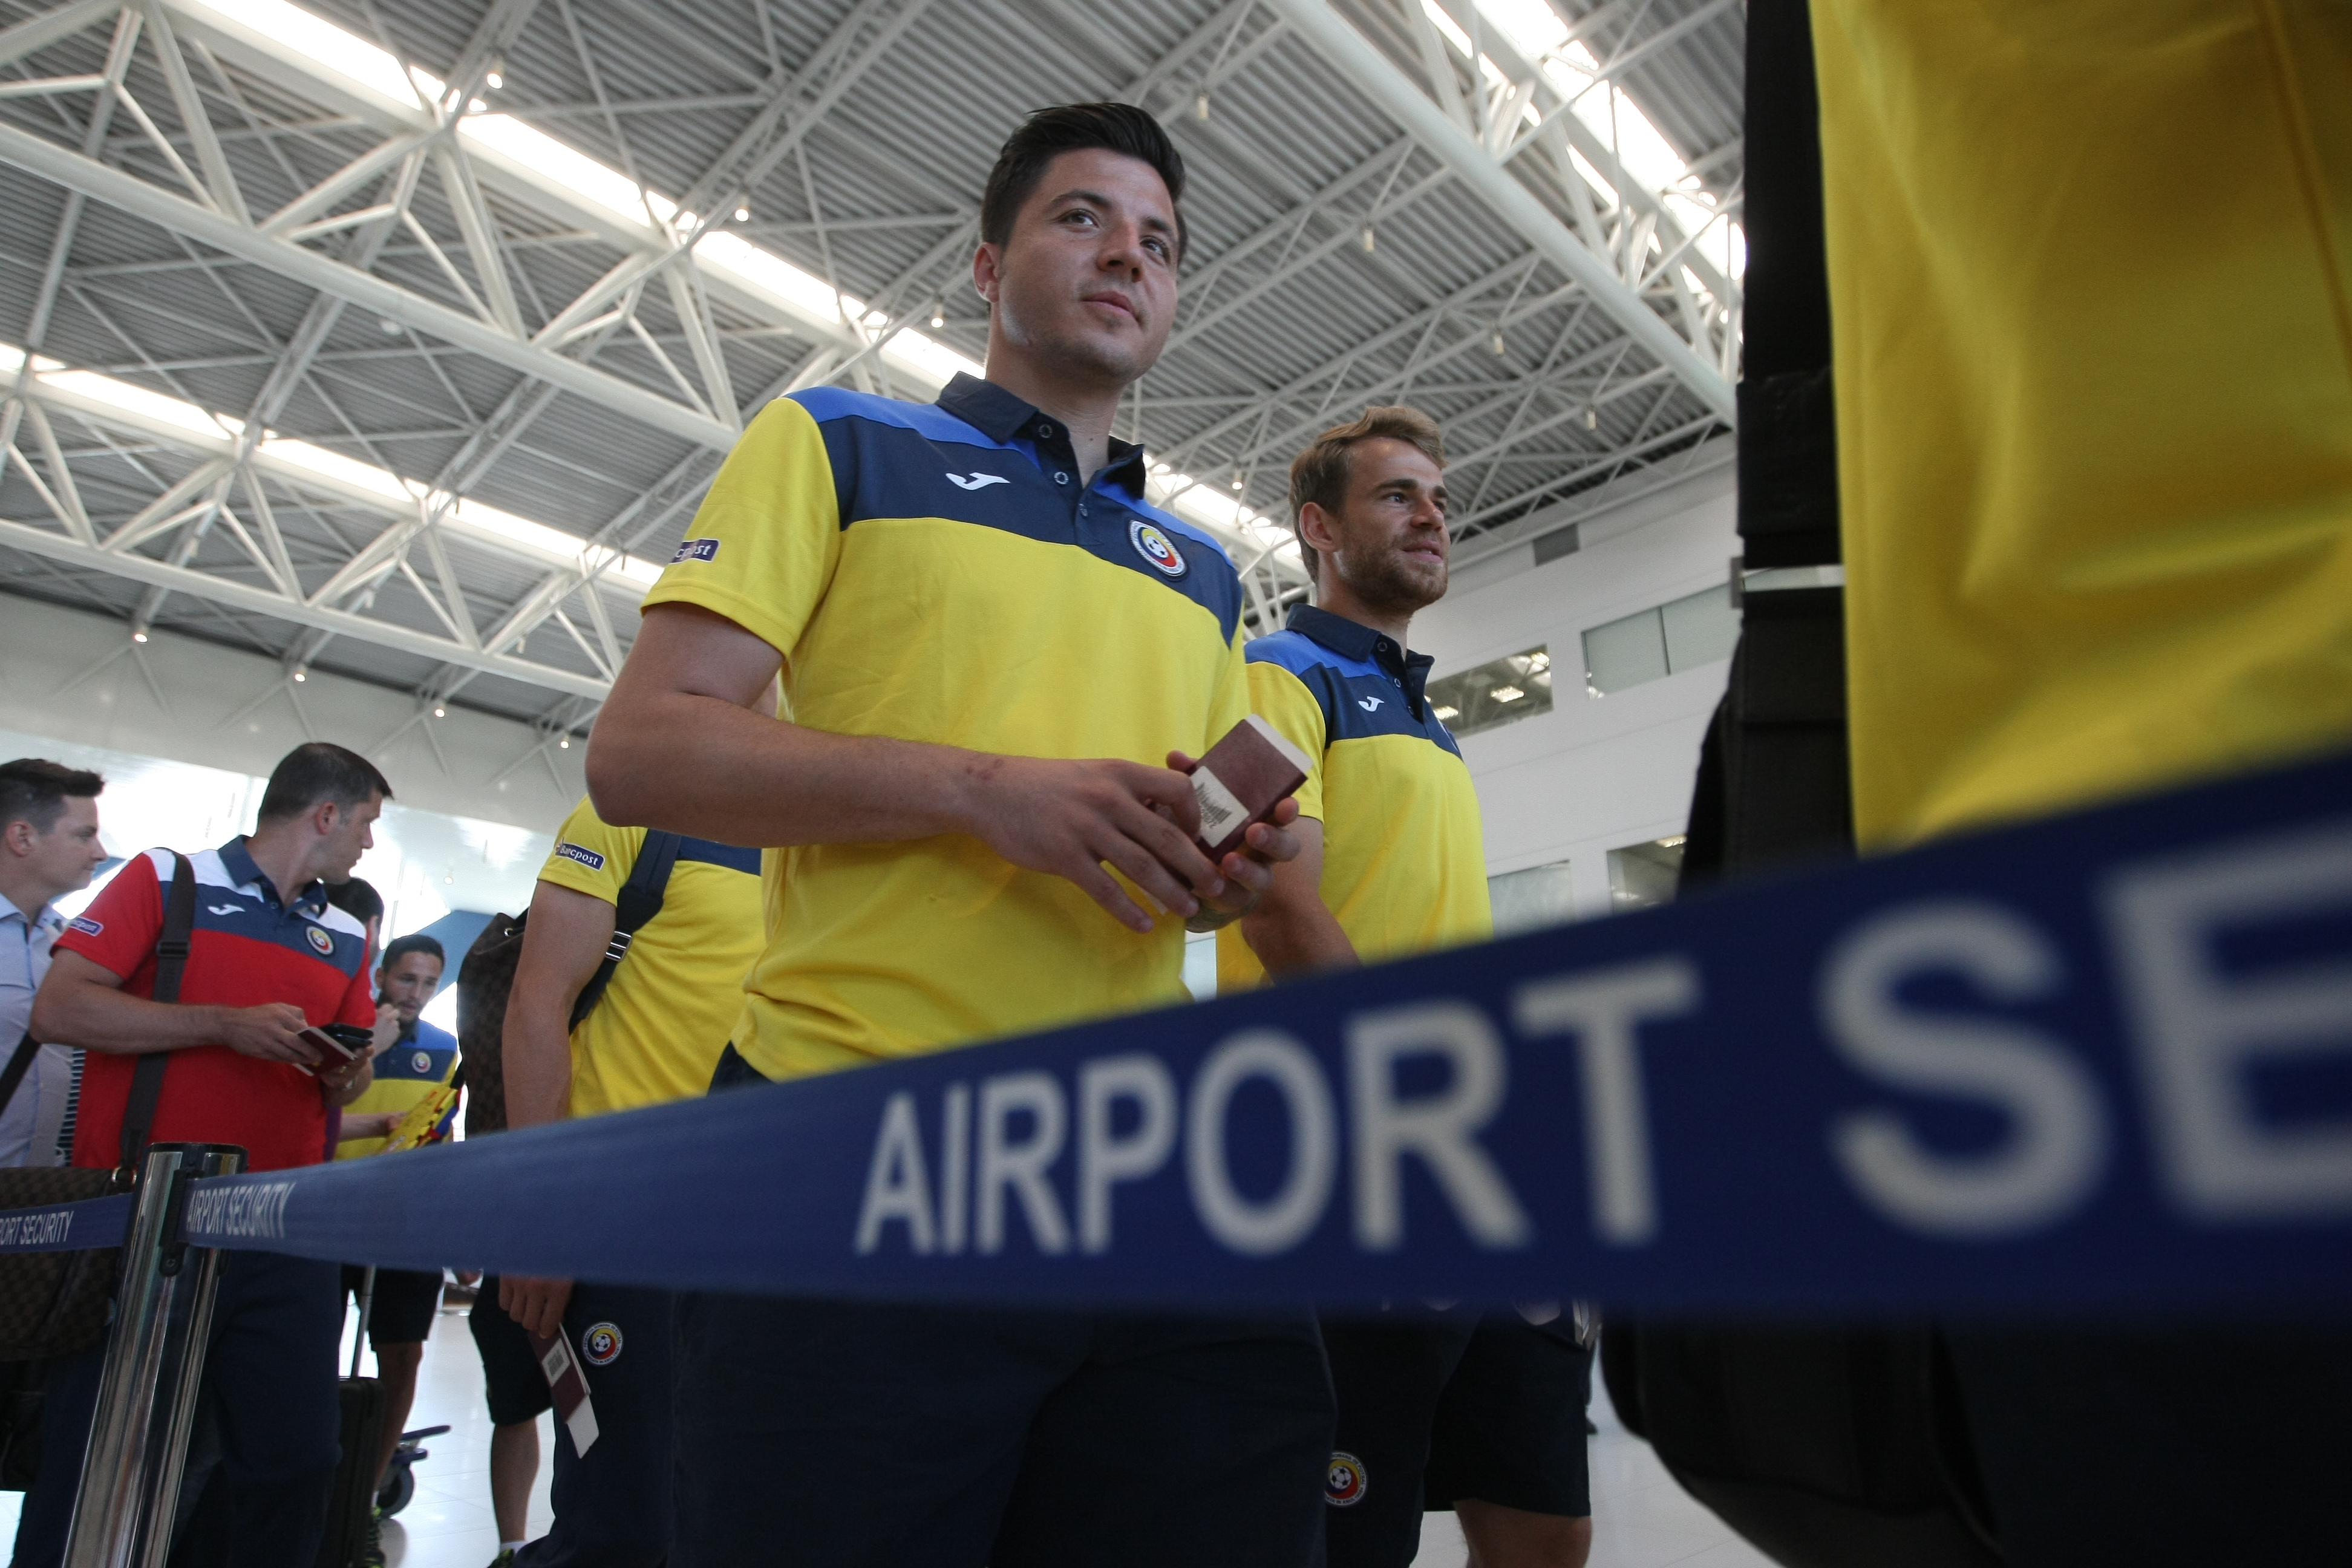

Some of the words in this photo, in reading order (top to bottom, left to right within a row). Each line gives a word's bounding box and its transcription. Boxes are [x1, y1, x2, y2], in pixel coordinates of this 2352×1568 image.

[854, 957, 1701, 1258] AIRPORT
[1817, 830, 2352, 1236] SE
[20, 1210, 74, 1244] SECURITY
[186, 1187, 231, 1234] AIRPORT
[226, 1182, 296, 1239] SECURITY
